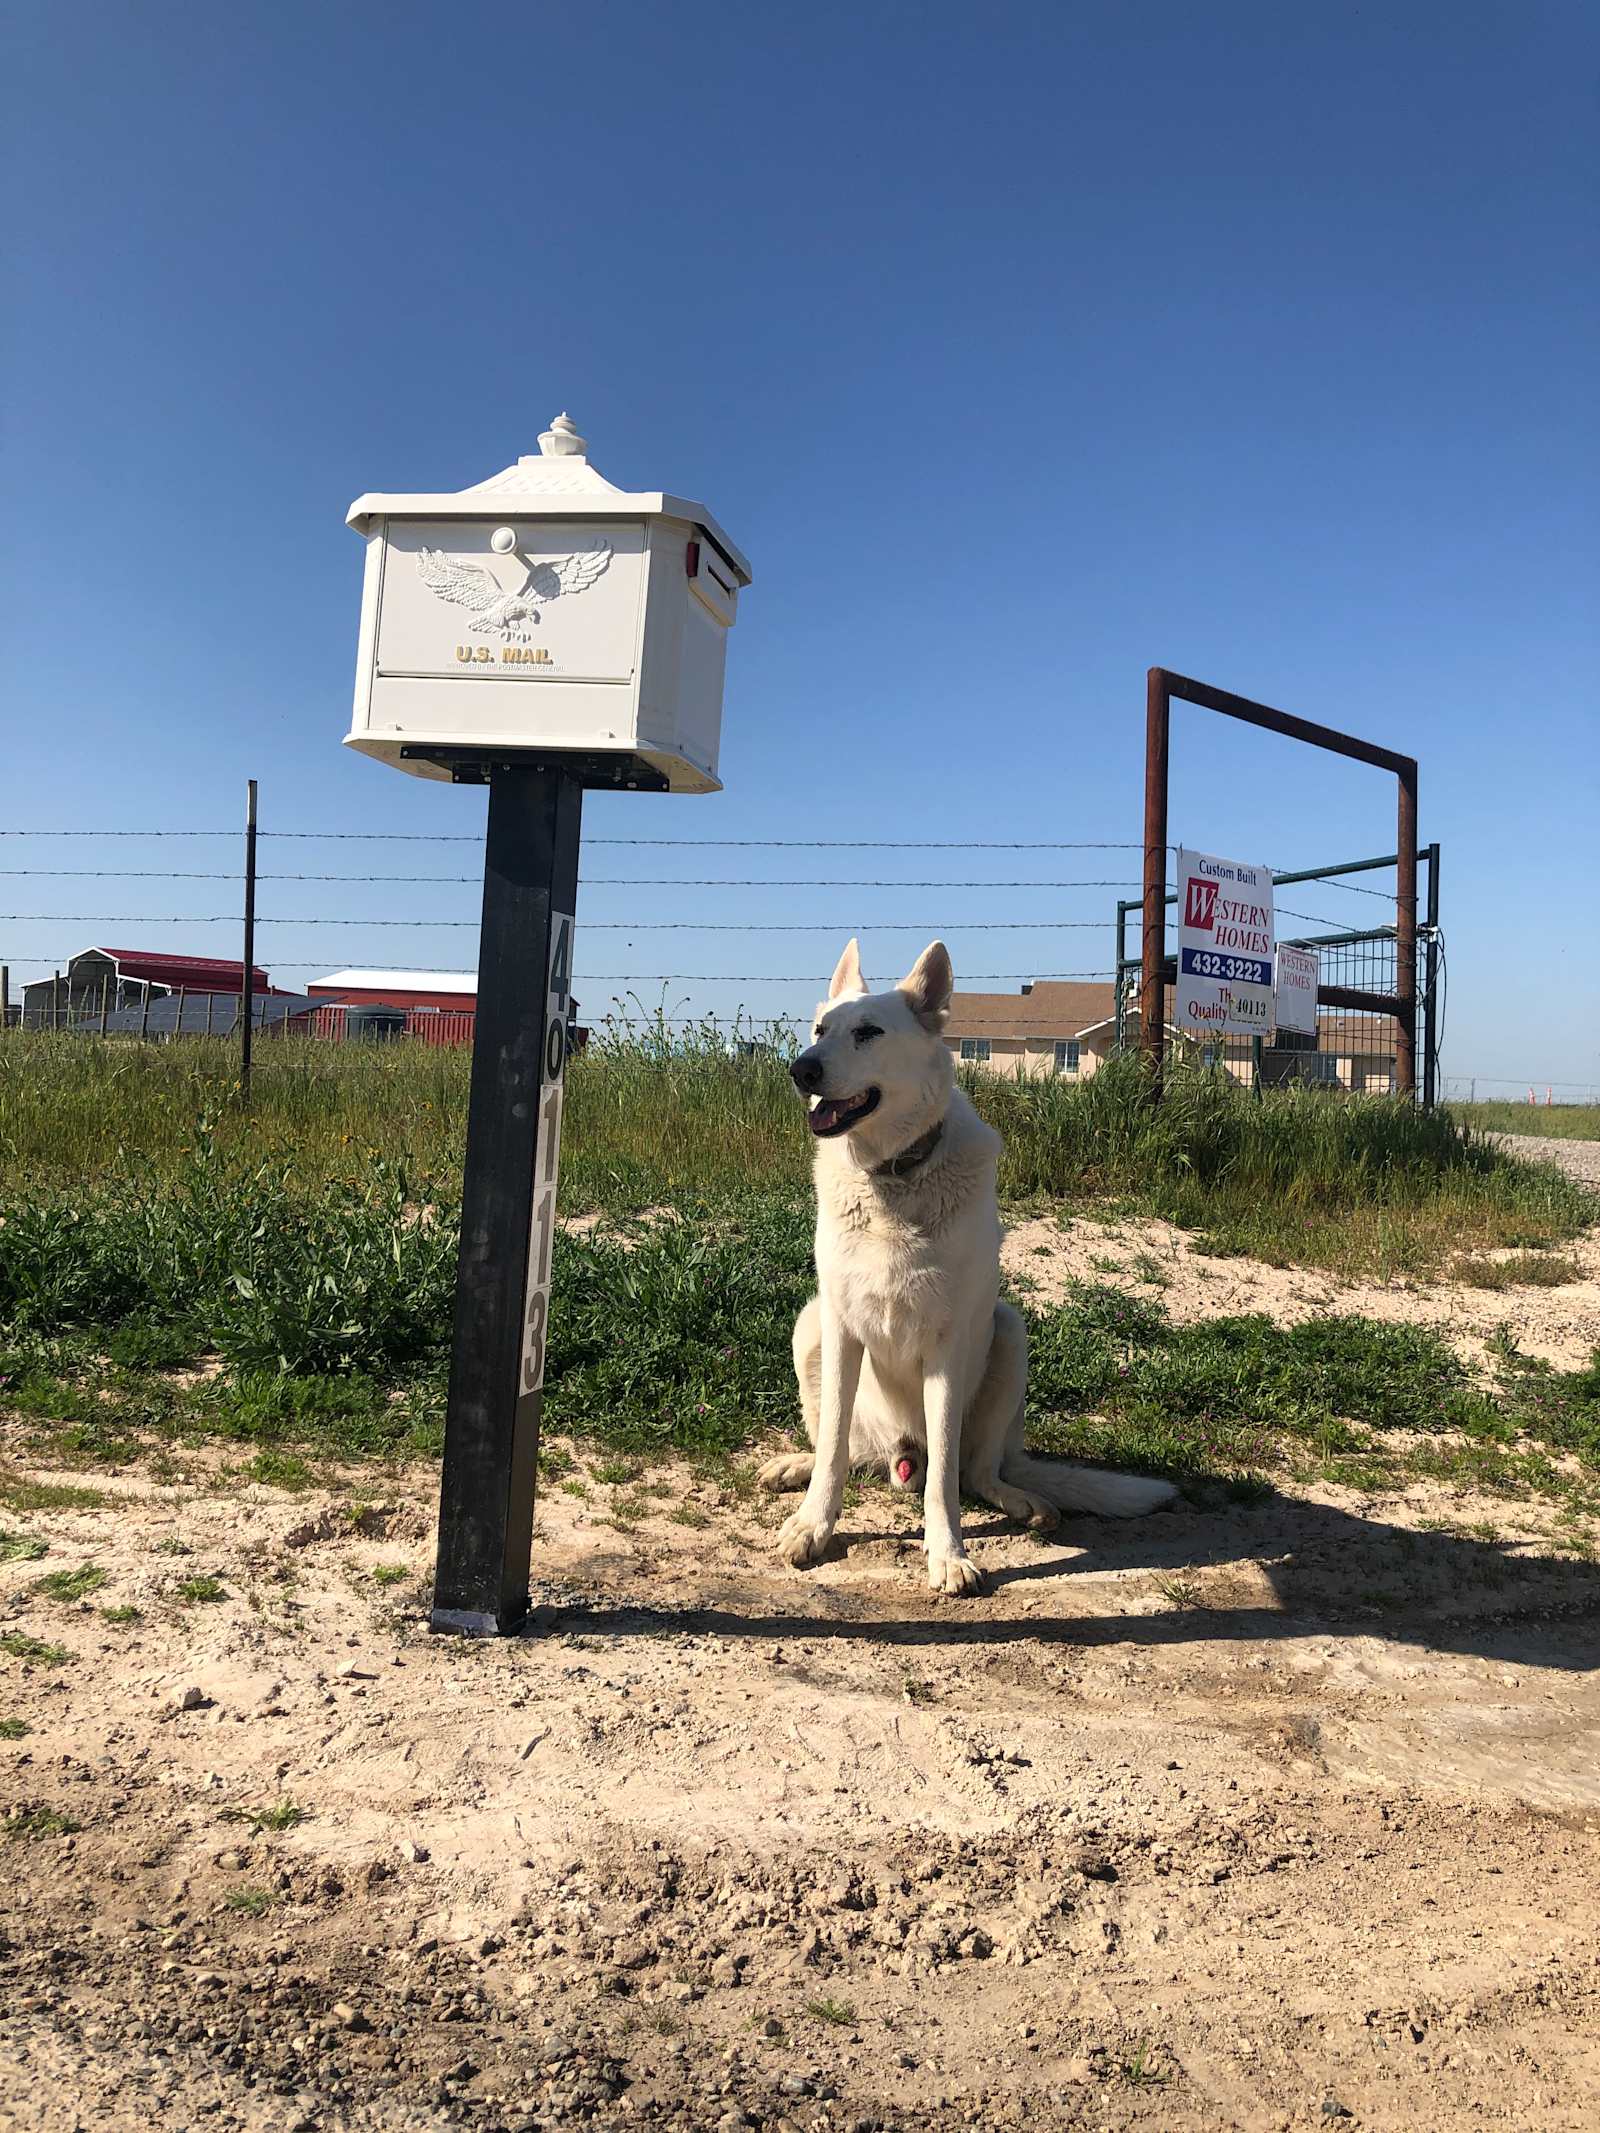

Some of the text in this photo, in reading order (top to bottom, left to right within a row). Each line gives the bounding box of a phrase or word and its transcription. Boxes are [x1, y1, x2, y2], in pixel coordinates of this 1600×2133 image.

[456, 645, 554, 665] U.S. MAIL
[1199, 859, 1257, 886] Custom Built
[1190, 883, 1270, 929] WESTERN
[1215, 925, 1269, 954] HOMES
[1191, 952, 1262, 983] 432-3222
[1280, 952, 1316, 975] WESTERN
[1283, 971, 1312, 991] HOMES
[1188, 1000, 1228, 1026] Quality
[1235, 998, 1266, 1018] 40113
[523, 918, 571, 1392] 40113
